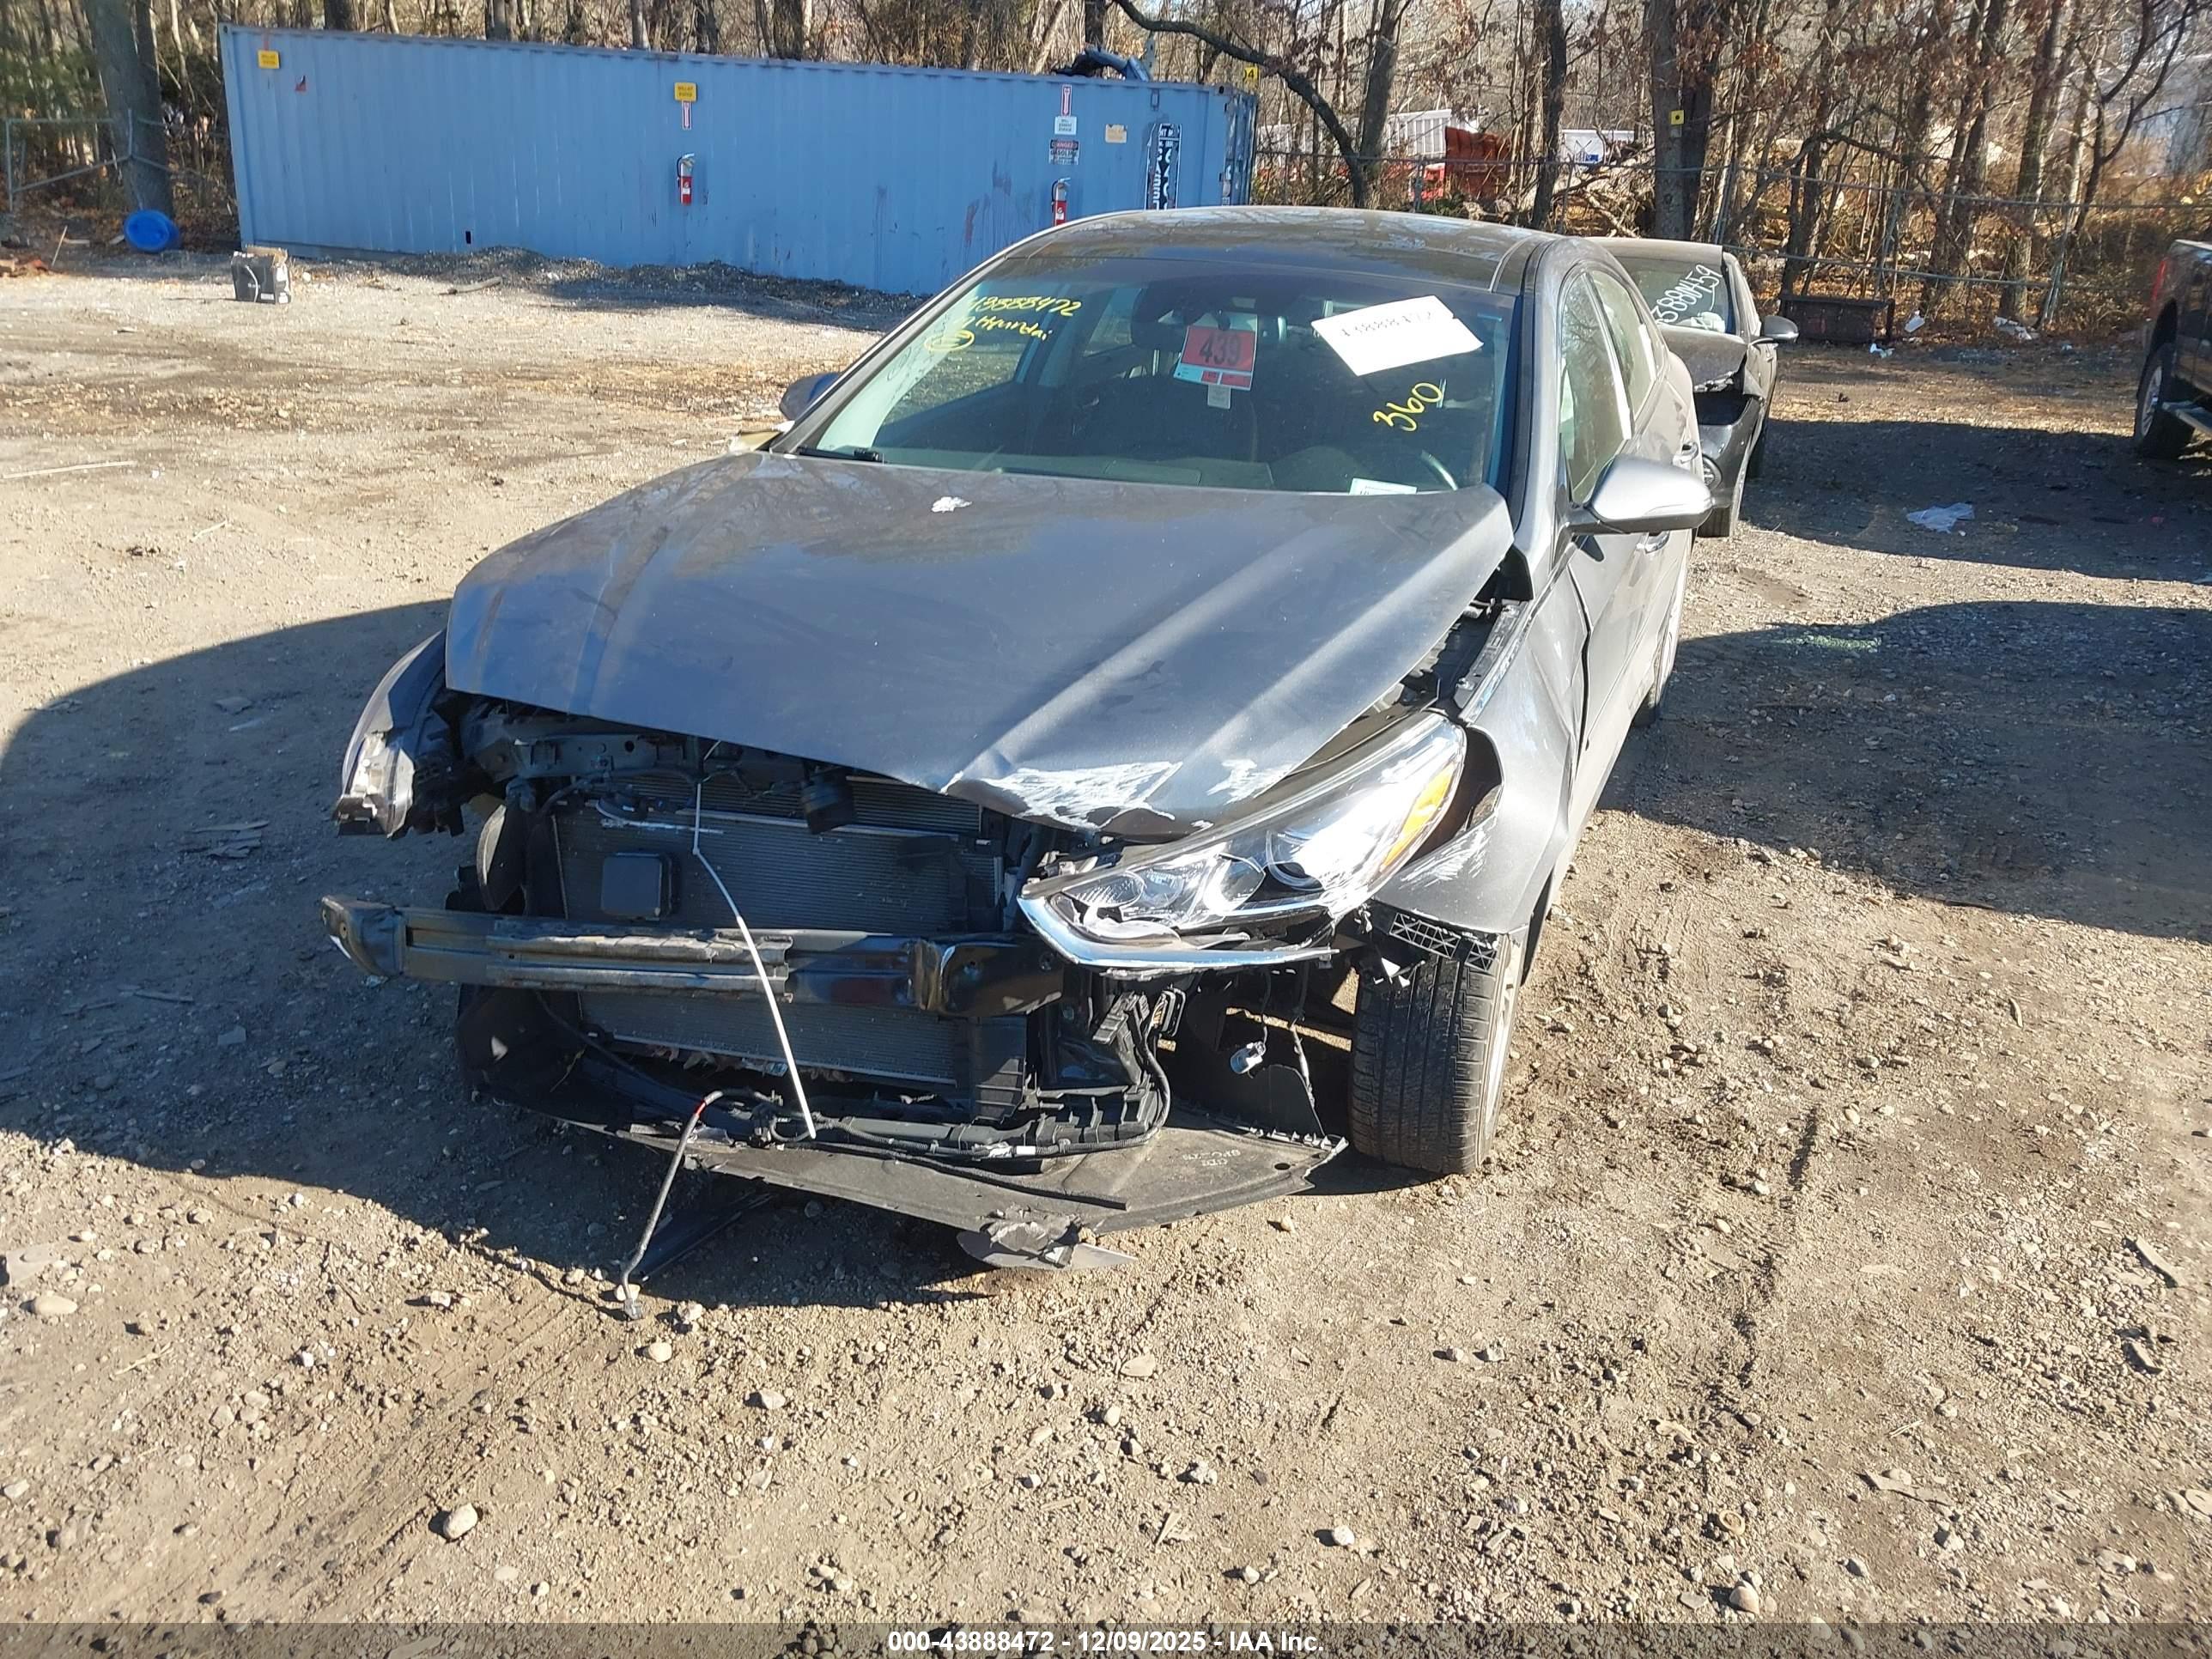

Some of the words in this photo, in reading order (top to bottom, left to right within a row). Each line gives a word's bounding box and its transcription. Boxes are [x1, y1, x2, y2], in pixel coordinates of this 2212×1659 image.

[1650, 264, 1723, 325] 3880459
[975, 315, 1052, 340] Hyundai
[1199, 331, 1240, 366] 439
[1373, 382, 1443, 431] 360
